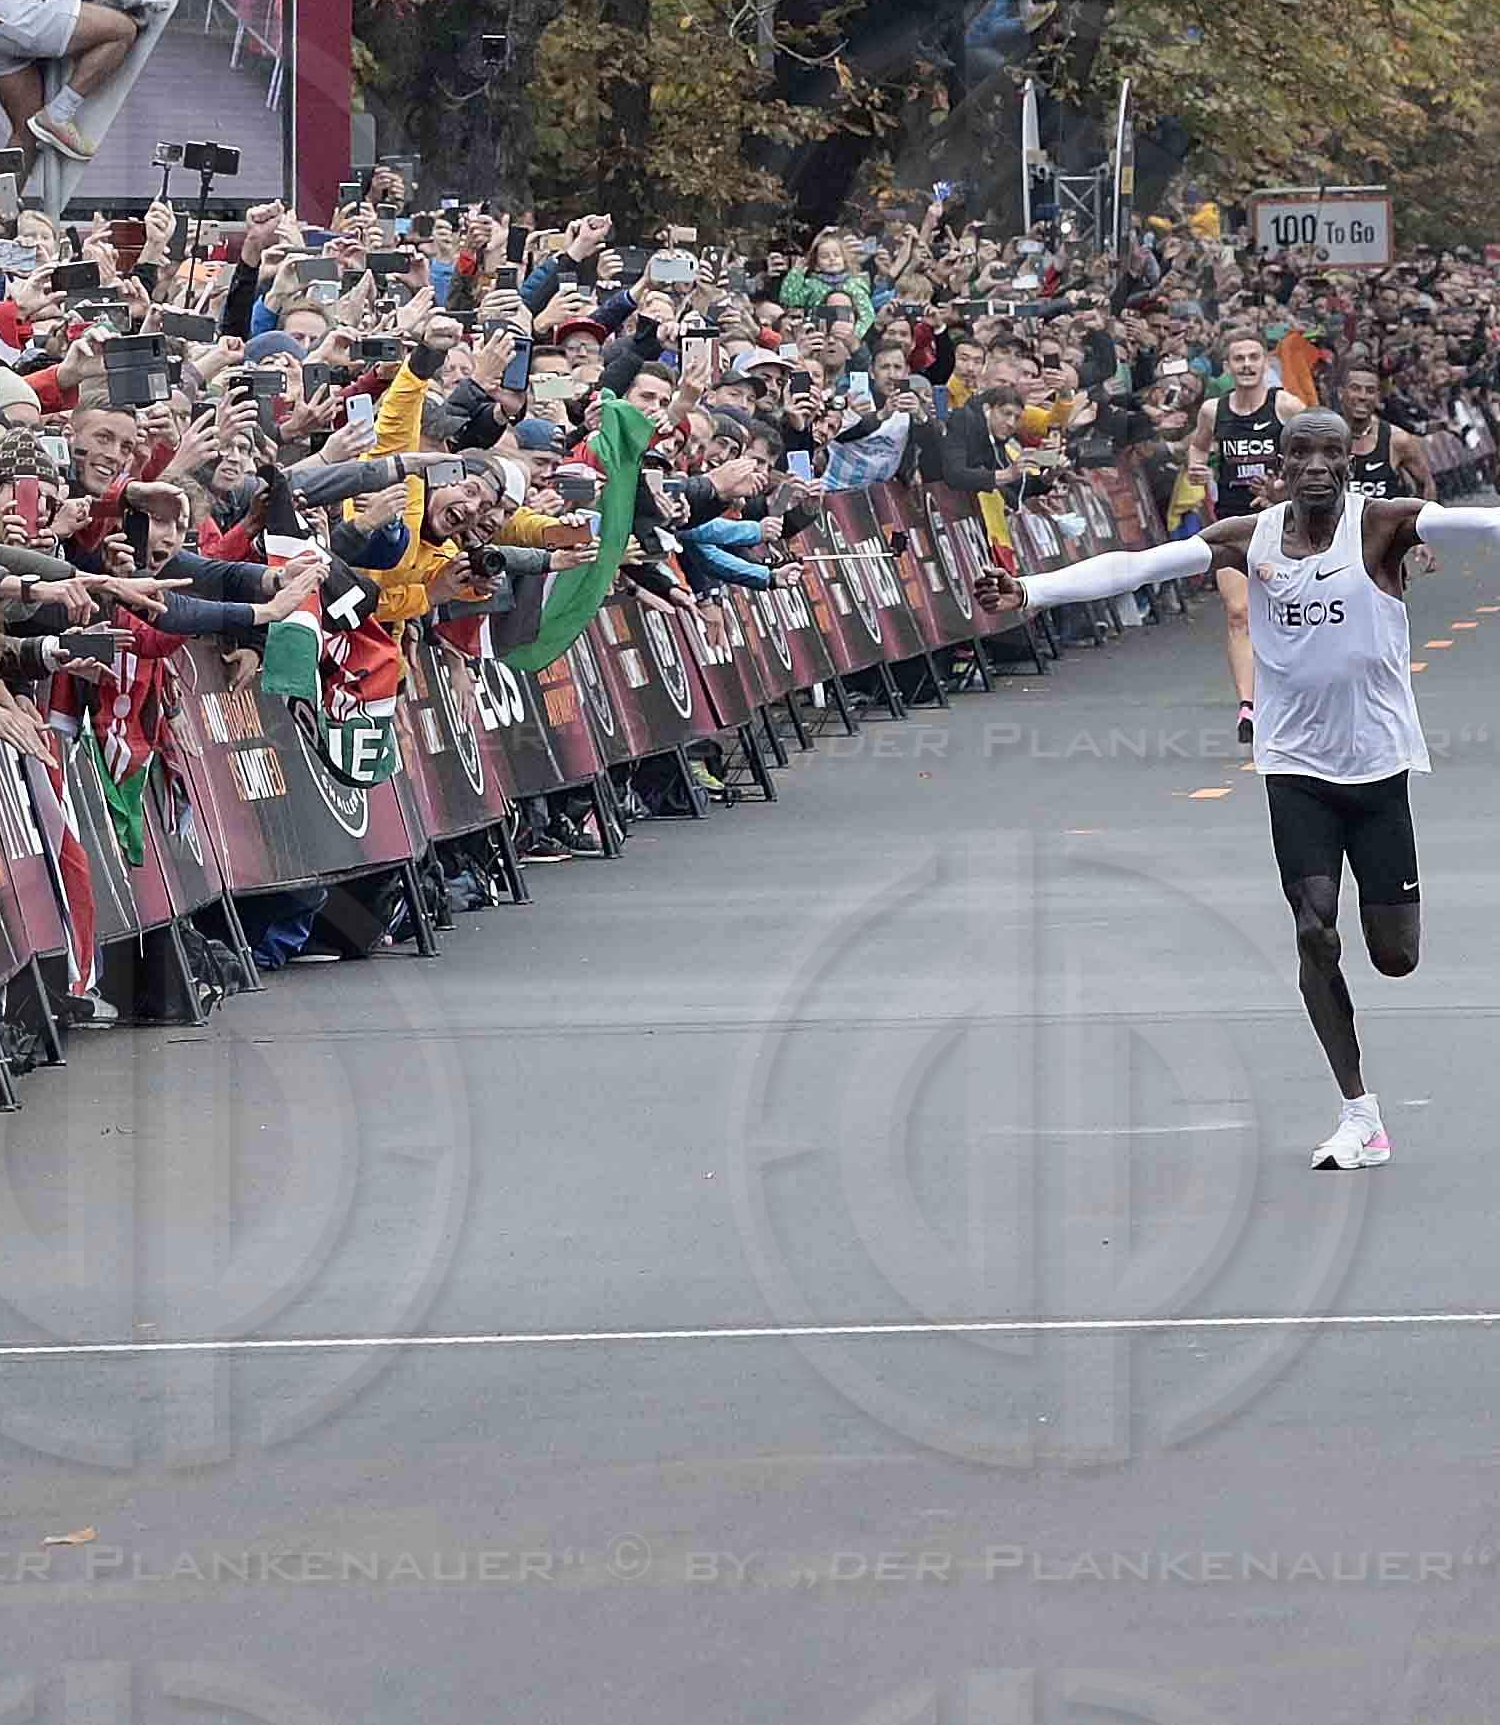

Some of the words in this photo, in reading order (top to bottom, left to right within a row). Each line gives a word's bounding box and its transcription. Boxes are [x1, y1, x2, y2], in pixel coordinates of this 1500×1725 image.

[1269, 214, 1318, 245] 100
[1324, 223, 1345, 245] To
[1349, 221, 1375, 245] Go
[1222, 438, 1276, 456] INEOS
[1350, 481, 1387, 497] EOS
[1267, 597, 1346, 627] INEOS
